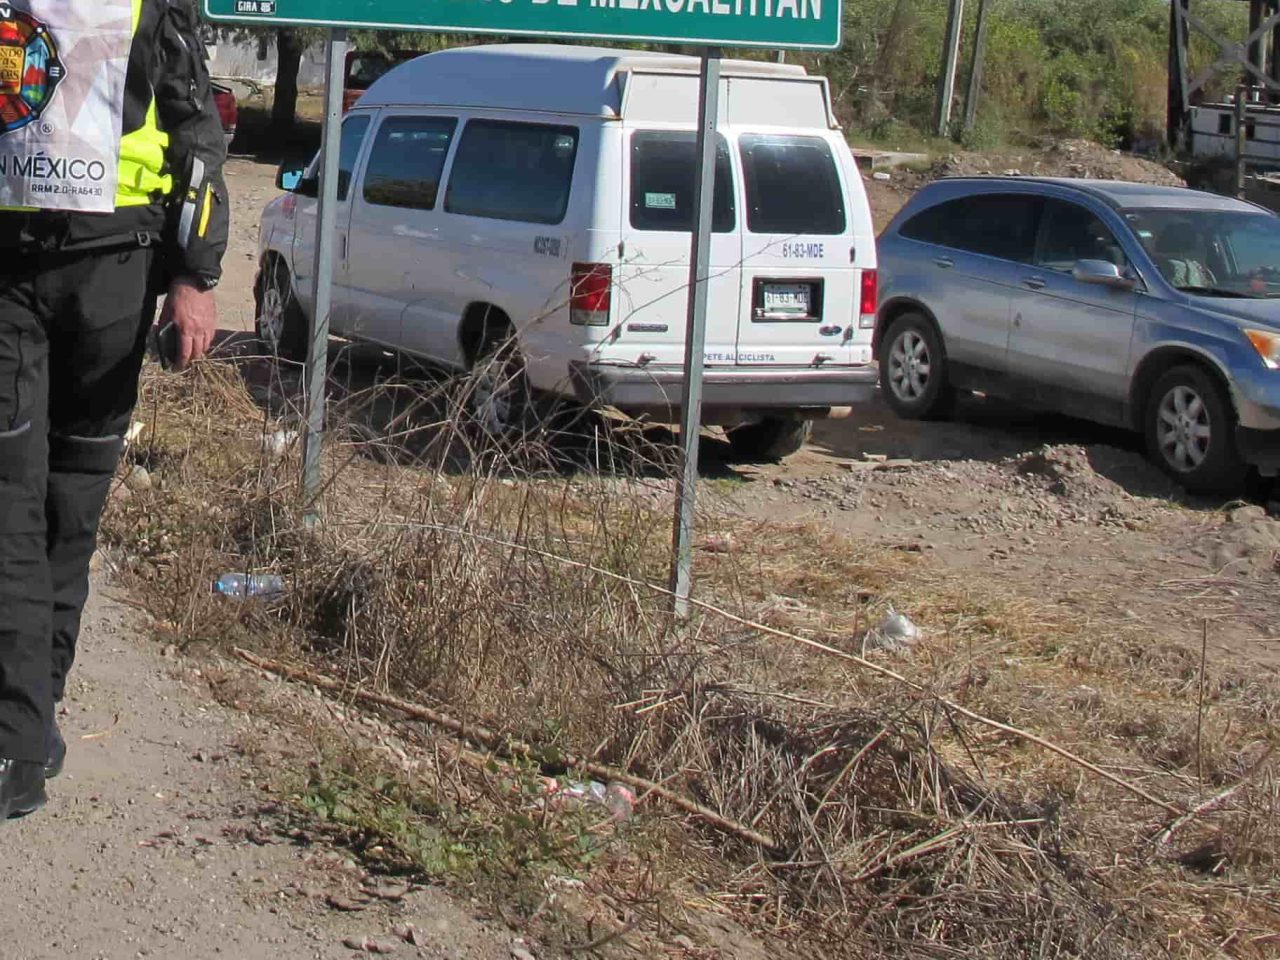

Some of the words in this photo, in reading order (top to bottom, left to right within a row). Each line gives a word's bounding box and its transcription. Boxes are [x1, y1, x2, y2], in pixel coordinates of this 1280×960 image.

[238, 1, 257, 11] GIRA
[14, 152, 106, 181] MÉXICO
[31, 184, 52, 193] RRM
[783, 243, 824, 258] 61-83-MDE
